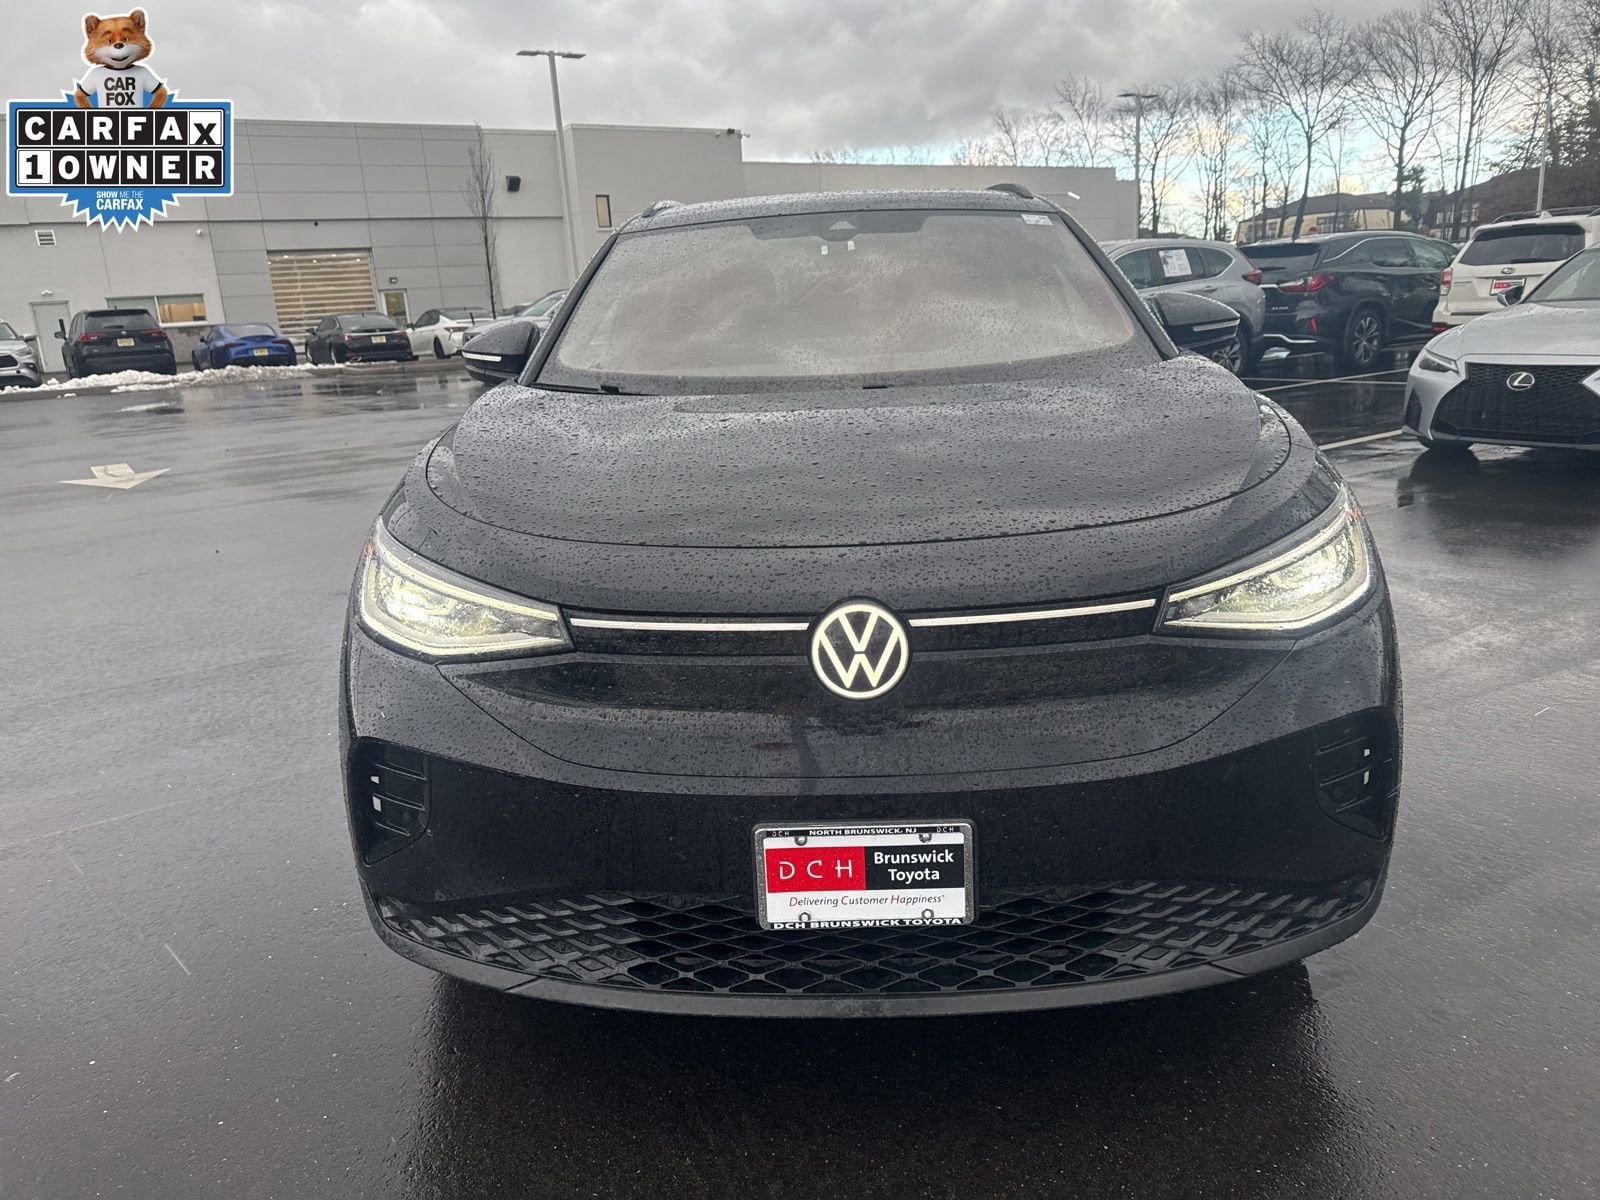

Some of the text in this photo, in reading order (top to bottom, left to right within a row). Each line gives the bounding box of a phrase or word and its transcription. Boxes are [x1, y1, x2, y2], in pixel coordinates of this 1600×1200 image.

[874, 850, 954, 864] Brunswick
[779, 860, 853, 880] DCH
[888, 868, 940, 884] Toyota
[789, 896, 838, 908] Delivering
[841, 896, 888, 906] Customer
[810, 919, 900, 928] BRUNSWICK
